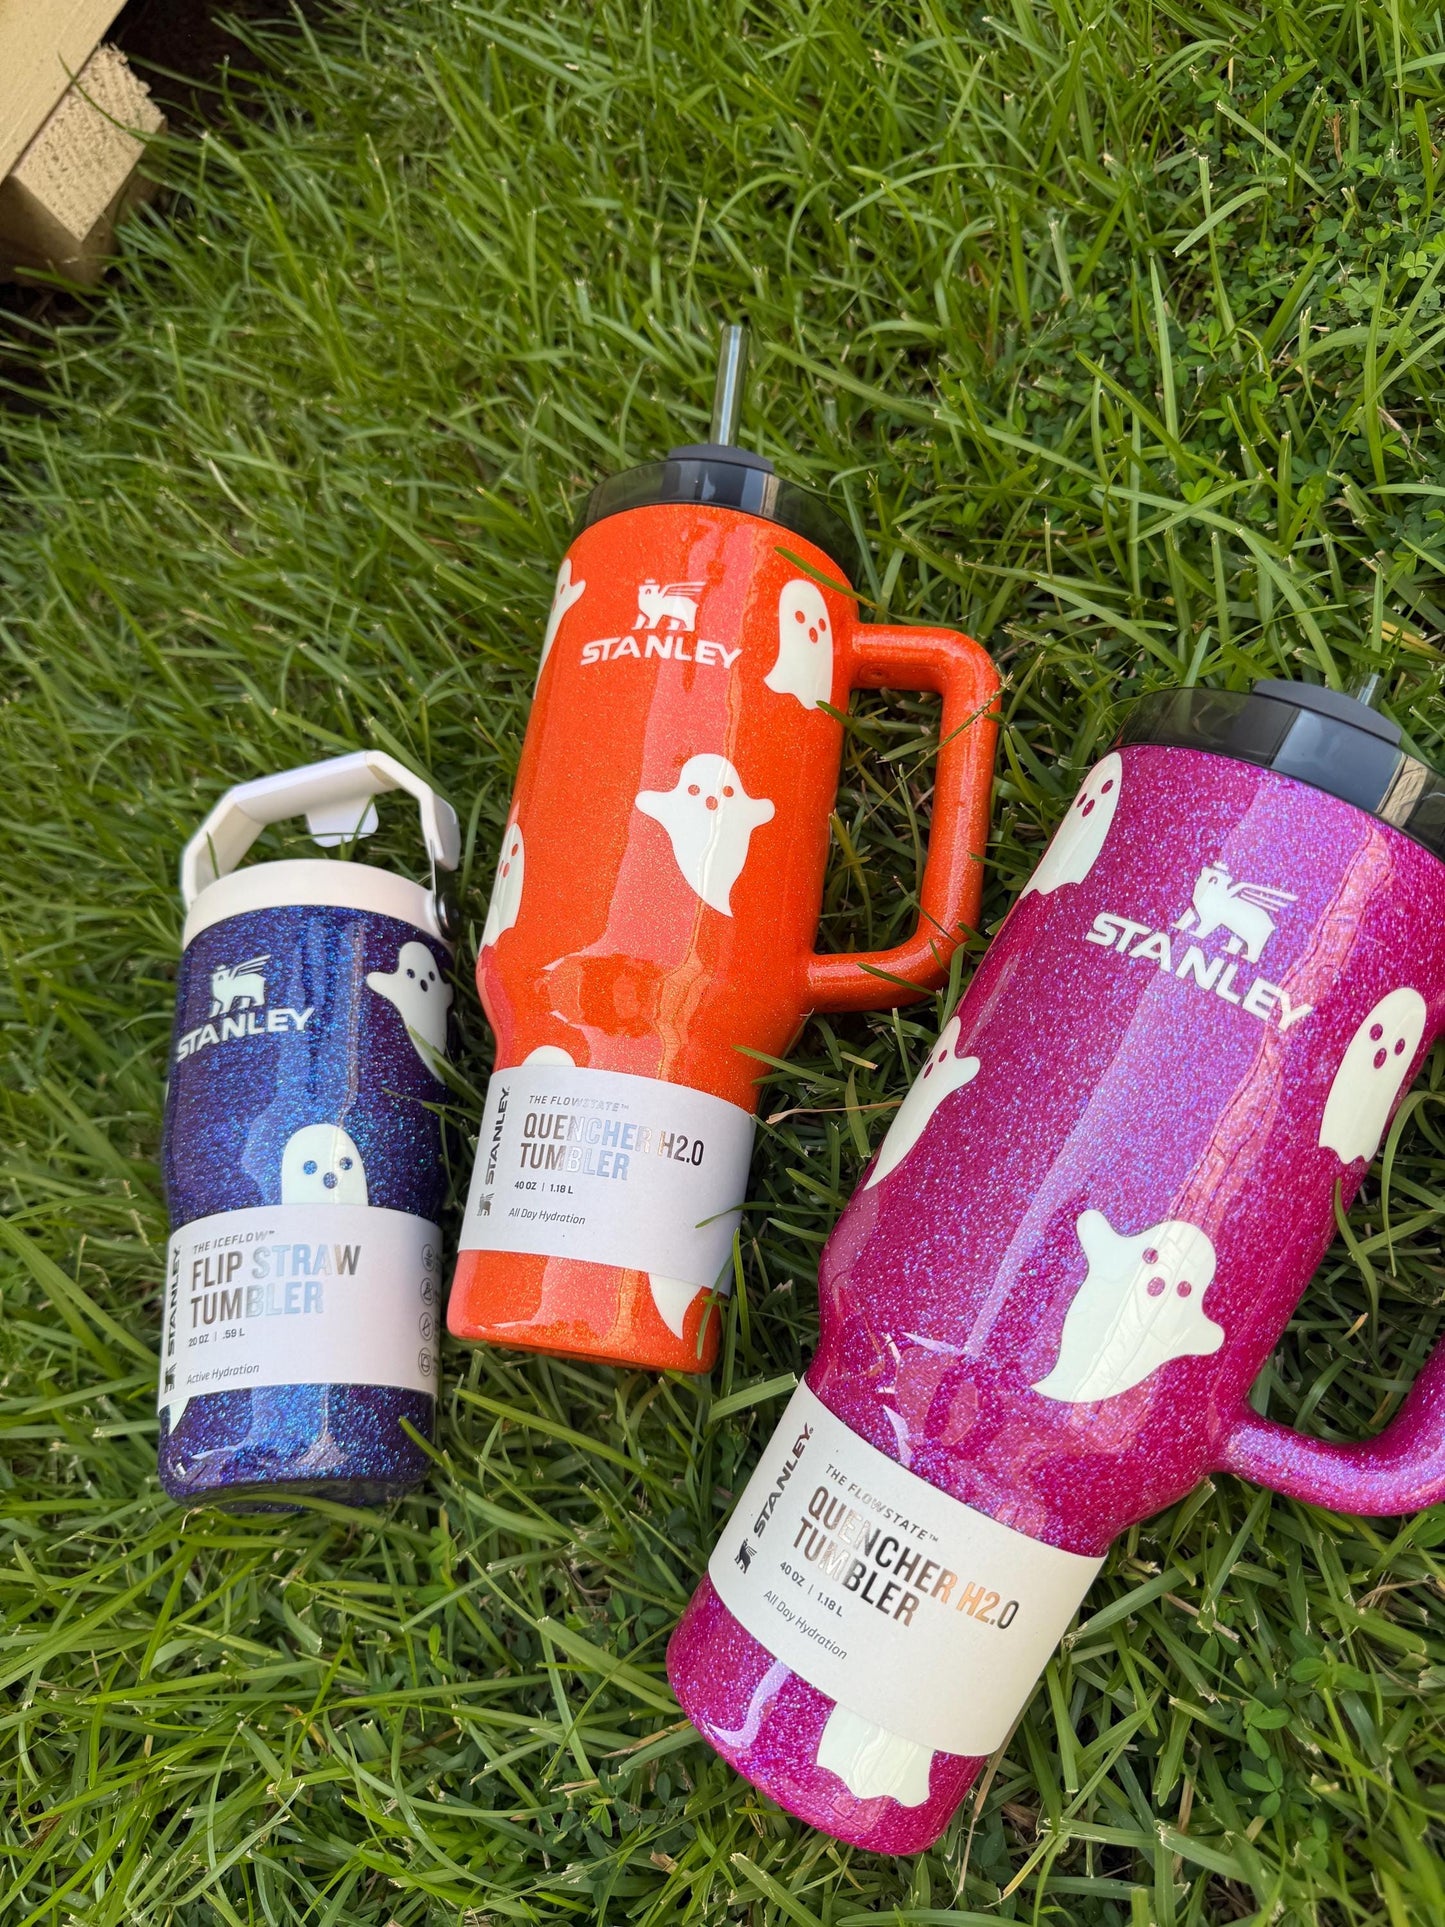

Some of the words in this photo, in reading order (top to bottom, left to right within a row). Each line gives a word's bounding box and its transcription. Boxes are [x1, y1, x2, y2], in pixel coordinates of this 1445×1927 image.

[580, 635, 743, 670] STANLEY
[1085, 912, 1314, 1032] STANLEY
[176, 1007, 315, 1063] STANLEY
[529, 1095, 548, 1105] THE
[523, 1112, 652, 1153] QUENCHER
[520, 1142, 630, 1181] TUMBLER
[514, 1181, 525, 1190] 40
[526, 1181, 537, 1190] OZ
[550, 1184, 566, 1194] 1.18
[567, 1185, 574, 1194] L
[508, 1208, 520, 1217] All
[521, 1208, 538, 1220] Day
[539, 1210, 586, 1225] Hydration
[191, 1251, 243, 1292] FLIP
[251, 1243, 362, 1279] STRAW
[193, 1240, 211, 1255] THE
[190, 1281, 325, 1329] TUMBLER
[188, 1335, 198, 1347] 20
[198, 1333, 209, 1344] OZ
[222, 1329, 237, 1340] .59
[238, 1327, 245, 1337] L
[186, 1371, 211, 1385] Active
[211, 1363, 260, 1381] Hydration
[825, 1463, 848, 1486] THE
[808, 1485, 960, 1605] QUENCHER
[780, 1561, 792, 1576] 40
[791, 1571, 806, 1588] OZ
[817, 1592, 836, 1611] 1.18
[836, 1605, 843, 1618] L
[793, 1516, 920, 1627] TUMBLER
[763, 1590, 779, 1606] All
[776, 1601, 796, 1622] Day
[795, 1616, 848, 1660] Hydration
